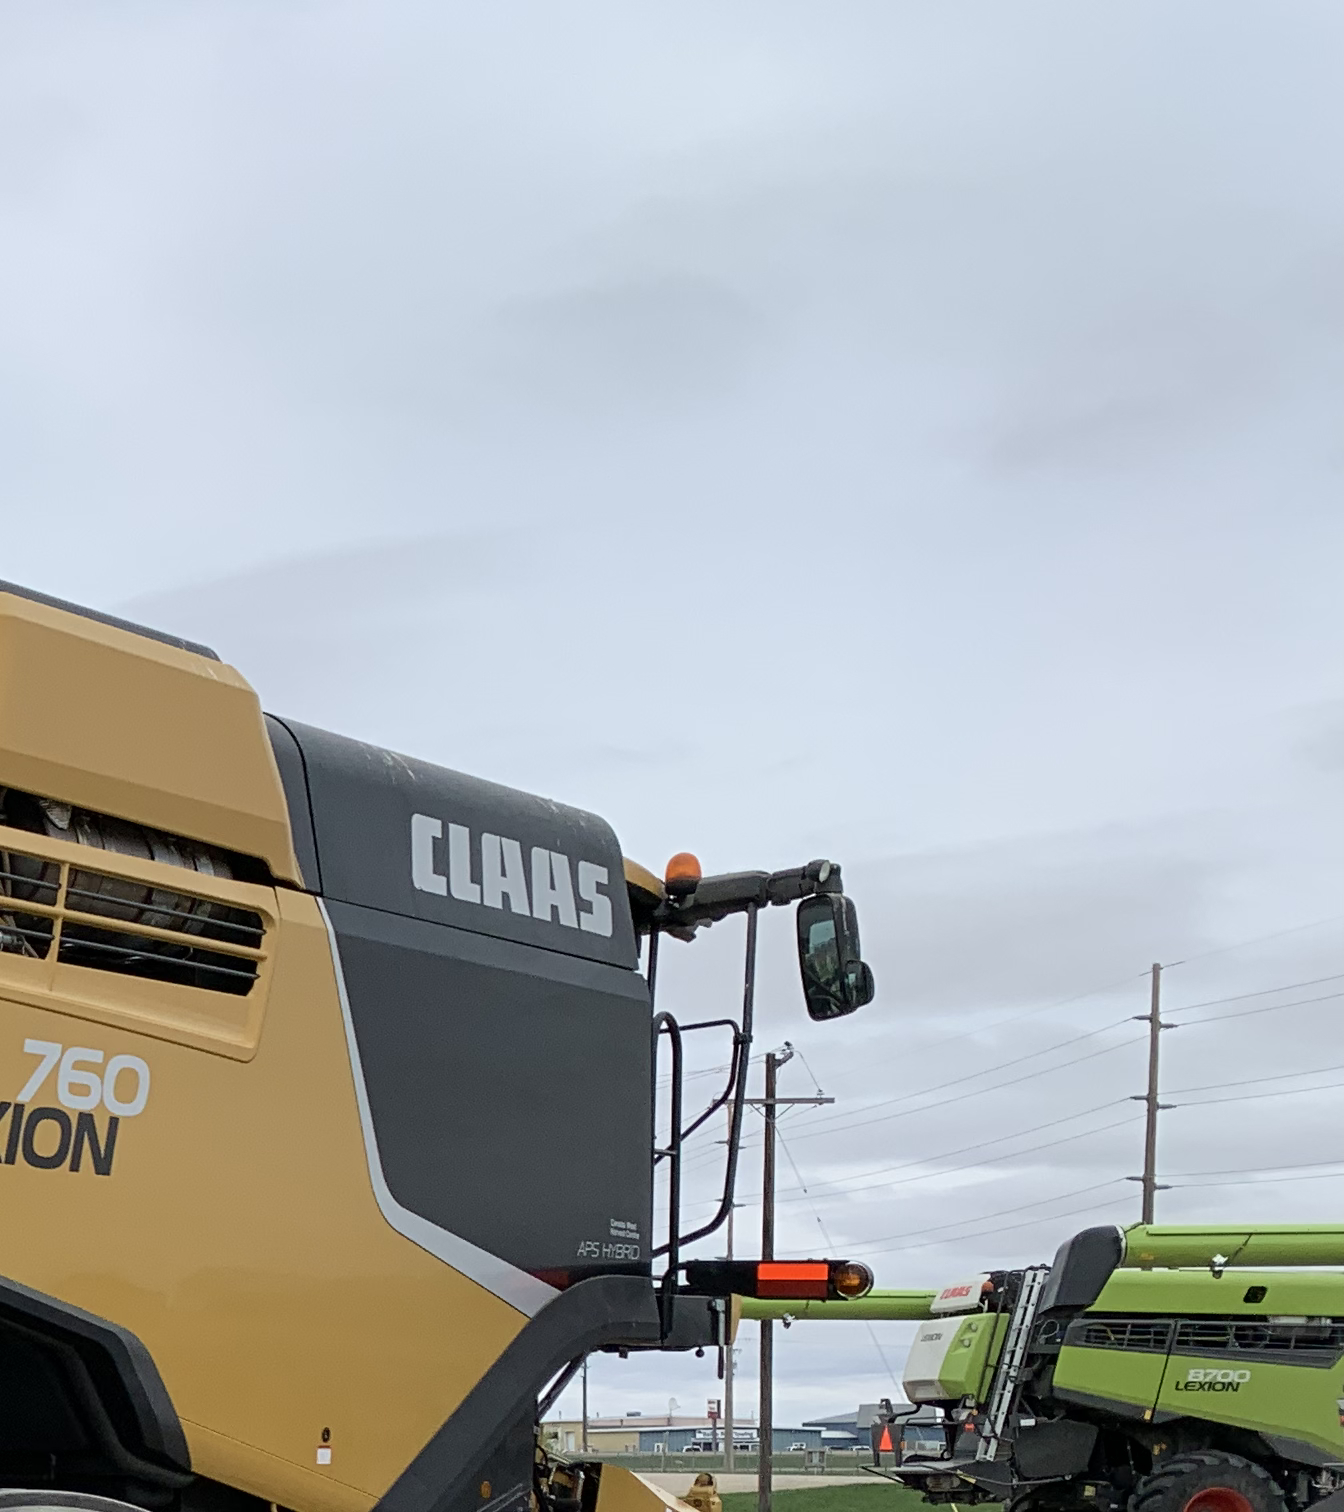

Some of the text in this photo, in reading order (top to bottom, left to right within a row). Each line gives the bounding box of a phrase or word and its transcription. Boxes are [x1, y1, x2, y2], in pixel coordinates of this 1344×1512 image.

[411, 812, 613, 938] CLAAS
[15, 1037, 151, 1117] 760
[576, 1240, 600, 1258] APS
[1187, 1368, 1251, 1383] 8700
[1174, 1380, 1241, 1393] LEXION
